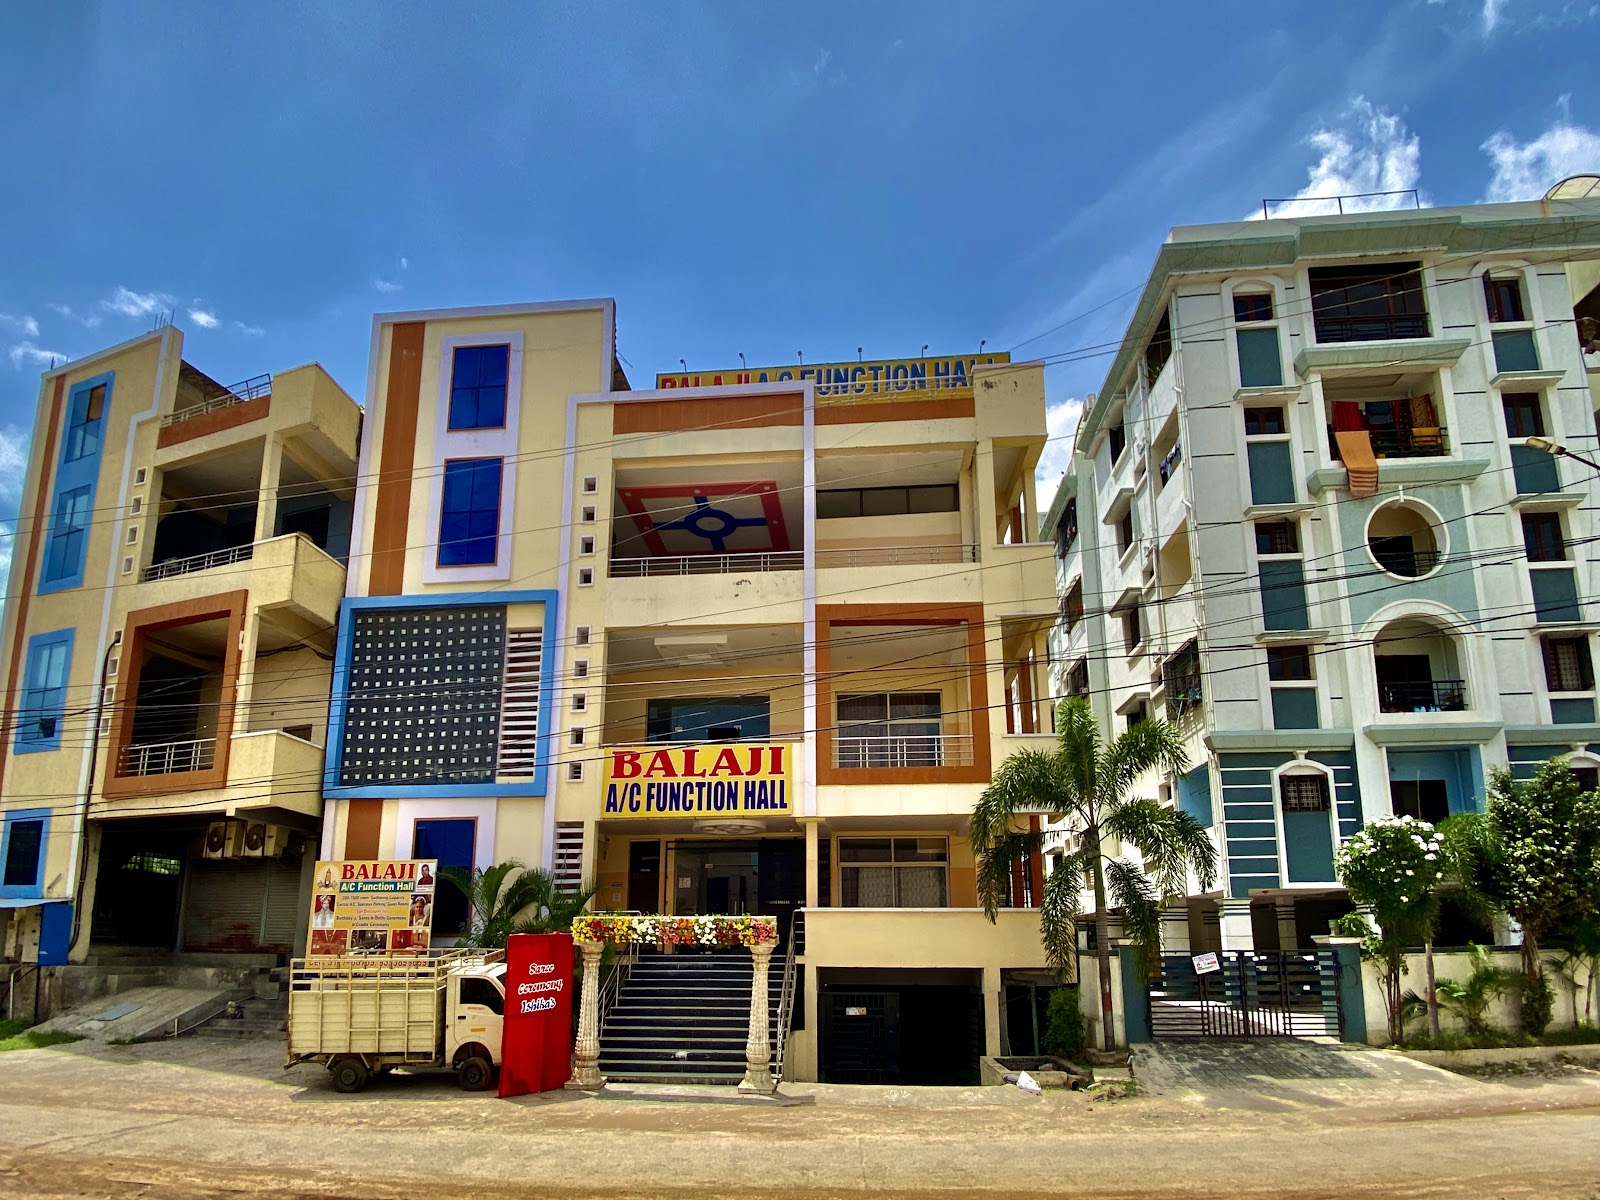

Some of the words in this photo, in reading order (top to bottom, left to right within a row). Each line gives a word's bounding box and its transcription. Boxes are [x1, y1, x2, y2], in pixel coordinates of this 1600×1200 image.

[934, 357, 994, 389] HA
[610, 746, 785, 779] BALAJI
[605, 782, 642, 813] A/C
[645, 780, 739, 812] FUNCTION
[743, 779, 788, 810] HALL
[341, 863, 415, 880] BALAJI
[341, 882, 356, 892] A/C
[357, 882, 395, 892] Function
[396, 881, 414, 891] Hall
[529, 963, 555, 975] Saree
[518, 979, 563, 995] Ceremony
